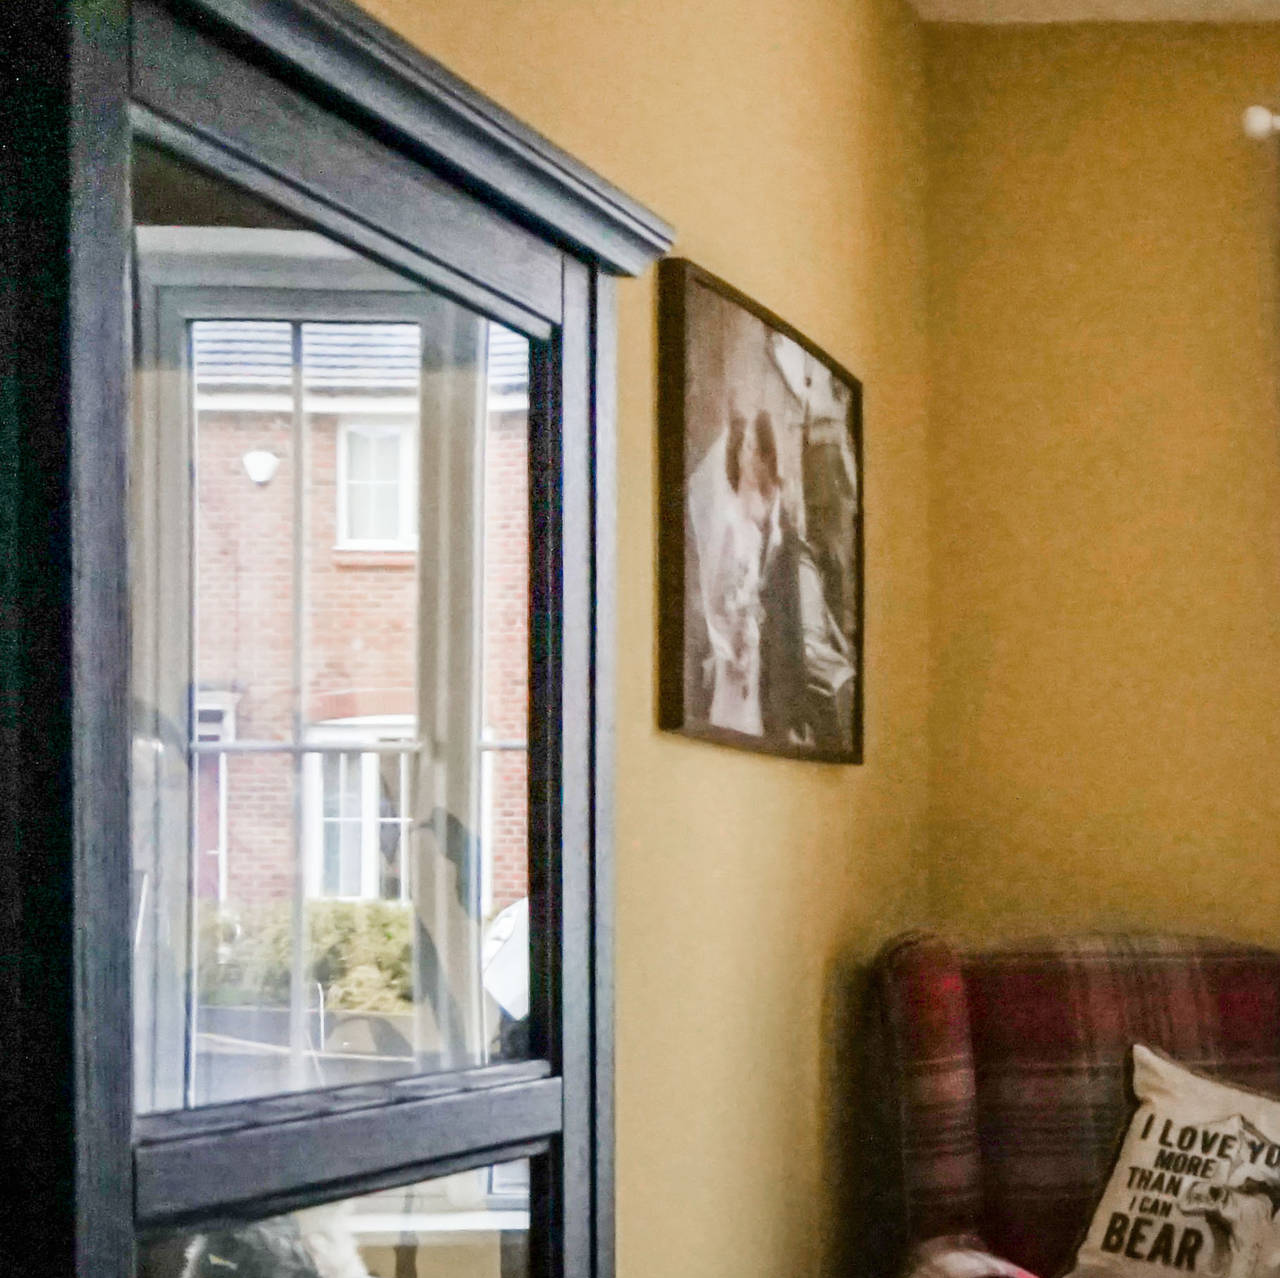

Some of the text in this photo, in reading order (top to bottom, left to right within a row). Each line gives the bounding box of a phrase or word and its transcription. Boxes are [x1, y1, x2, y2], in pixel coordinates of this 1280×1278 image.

[1141, 1113, 1156, 1140] I
[1158, 1119, 1237, 1159] LOVE
[1154, 1149, 1217, 1178] MORE
[1126, 1166, 1184, 1197] THAN
[1129, 1196, 1173, 1218] I CAN
[1101, 1212, 1204, 1272] BEAR
